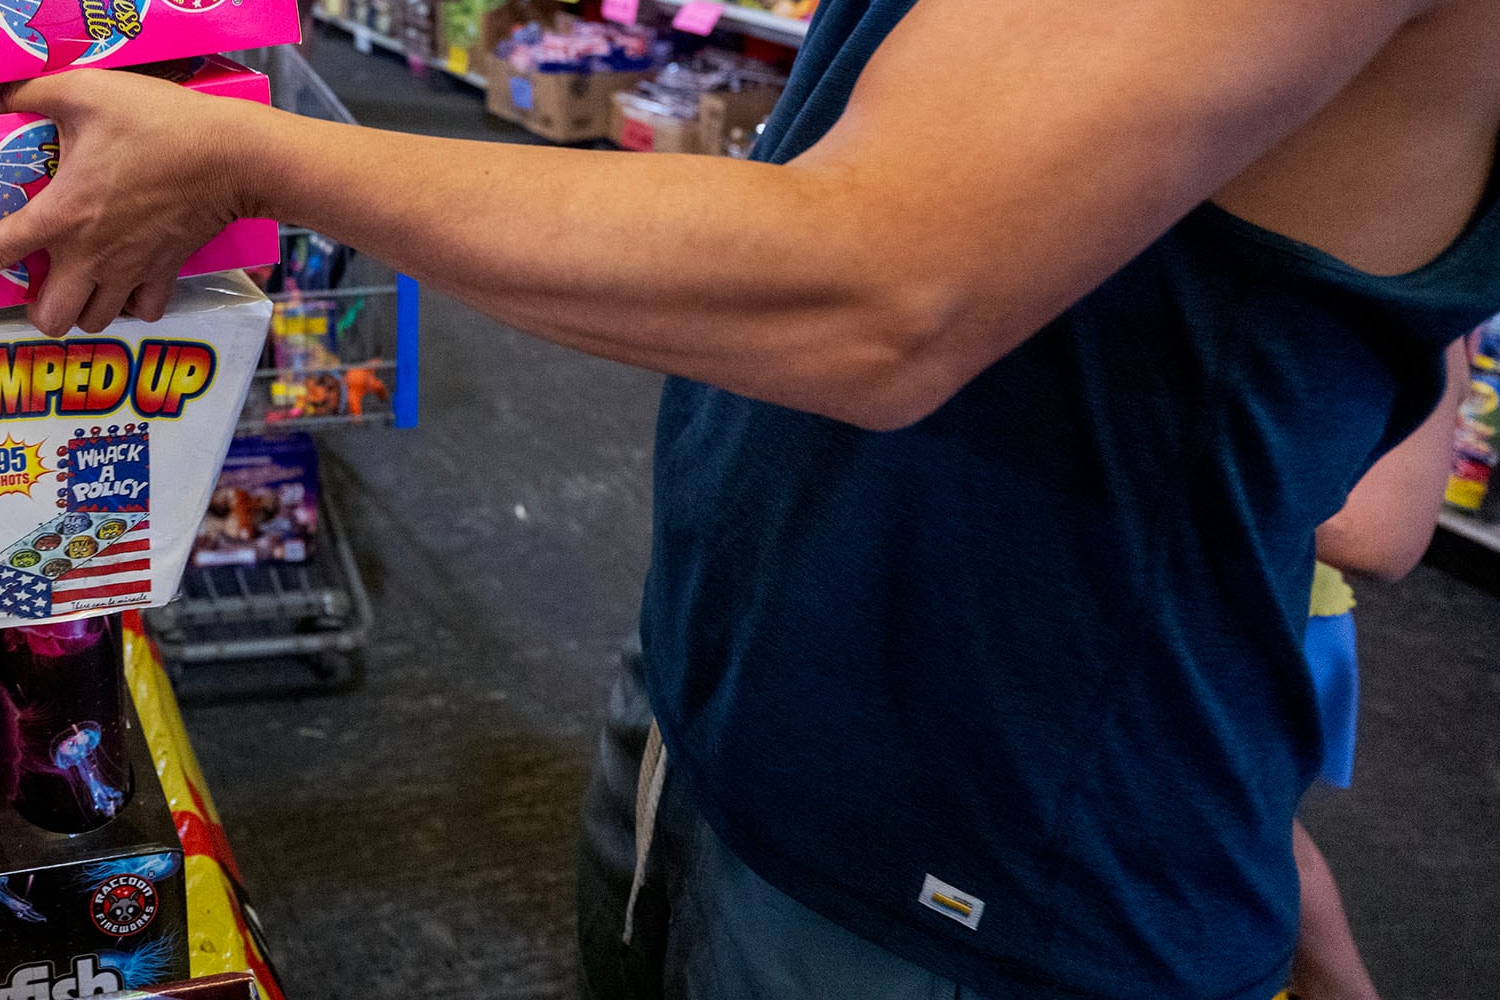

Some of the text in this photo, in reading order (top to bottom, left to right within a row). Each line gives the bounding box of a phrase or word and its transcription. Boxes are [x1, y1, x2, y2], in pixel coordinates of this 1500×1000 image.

[134, 342, 214, 418] UP
[76, 444, 146, 470] WHACK
[99, 465, 115, 482] A
[71, 480, 149, 502] POLICY
[95, 877, 153, 903] RACCOON
[95, 905, 154, 933] FIREWORKS
